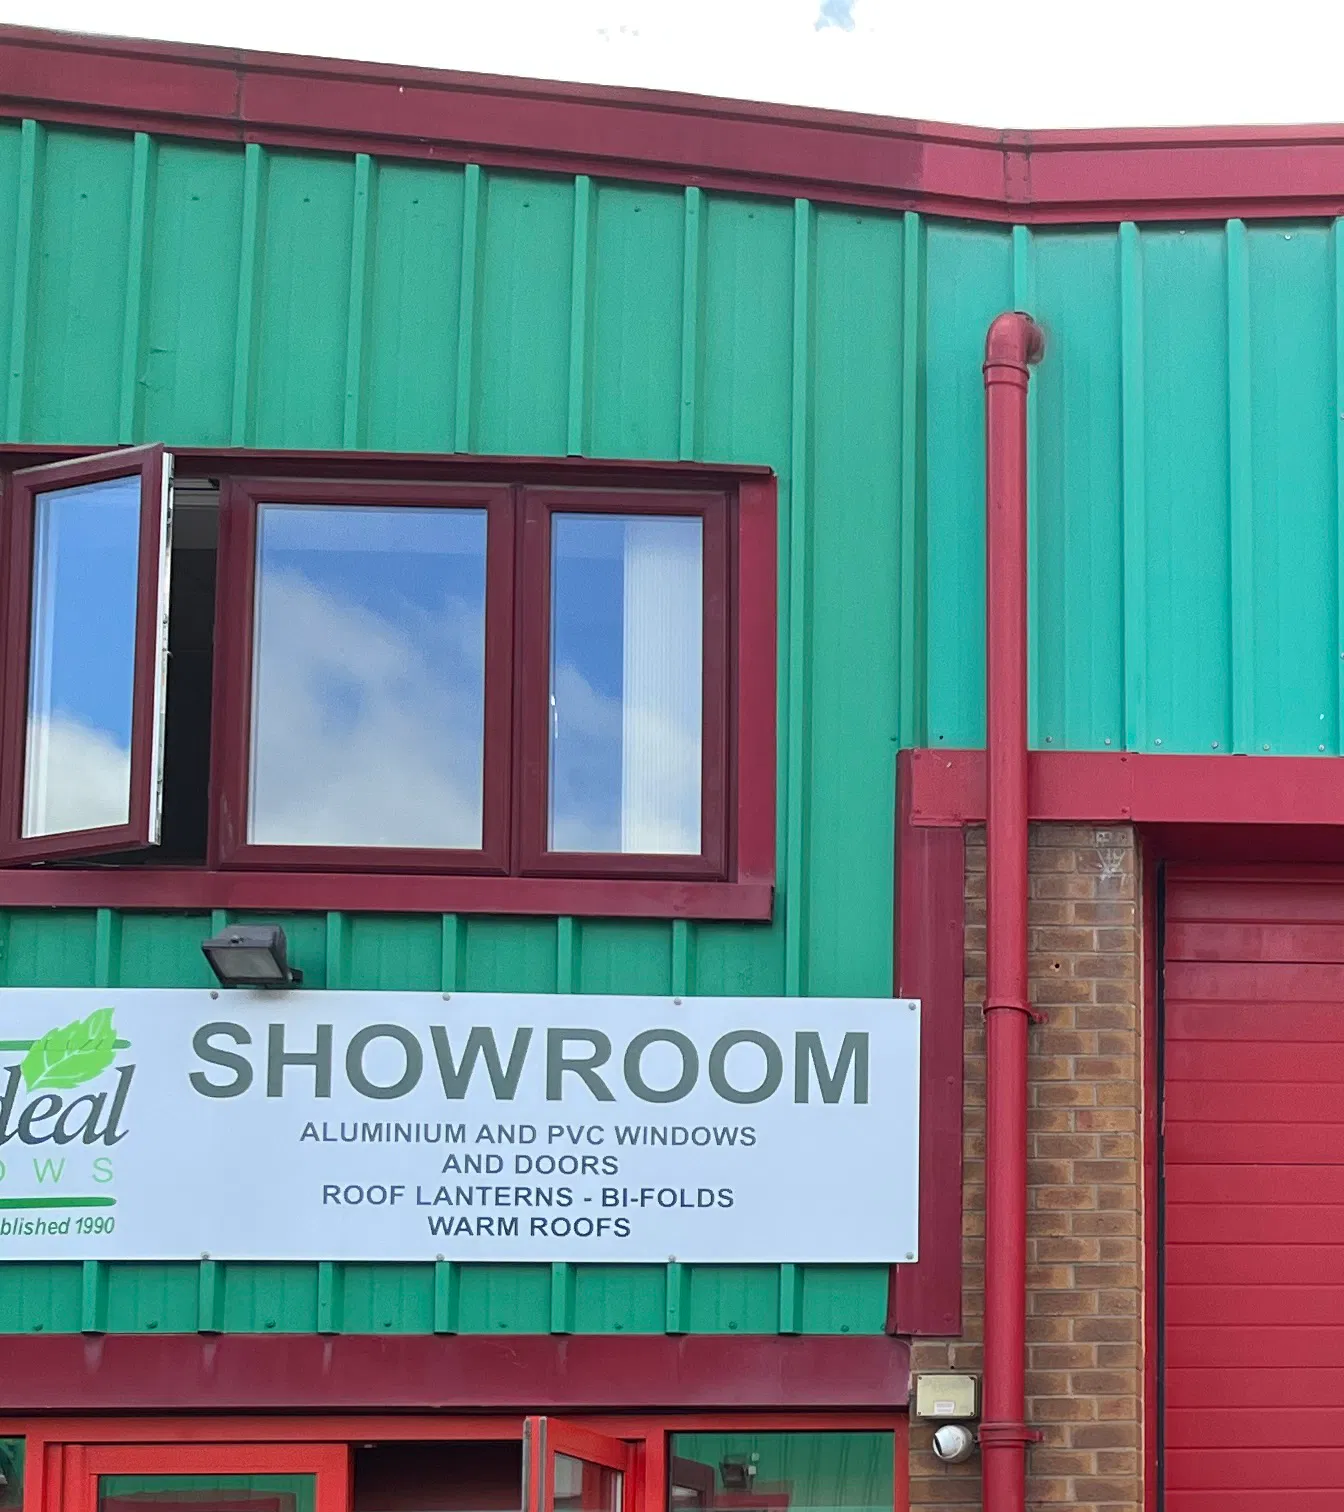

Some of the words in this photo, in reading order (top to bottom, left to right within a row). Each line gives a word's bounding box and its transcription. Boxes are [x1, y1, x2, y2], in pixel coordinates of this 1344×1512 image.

[189, 1021, 871, 1105] SHOWROOM
[300, 1121, 466, 1143] ALUMINIUM
[475, 1123, 537, 1144] AND
[548, 1125, 605, 1145] PVC
[614, 1126, 757, 1147] WINDOWS
[0, 1157, 114, 1184] WS
[442, 1153, 504, 1174] AND
[515, 1154, 619, 1175] DOORS
[323, 1184, 406, 1205] ROOF
[416, 1186, 574, 1207] LANTERNS
[602, 1187, 734, 1208] BI-FOLDS
[75, 1216, 115, 1235] 1990
[428, 1216, 518, 1236] WARM
[530, 1217, 631, 1238] ROOFS
